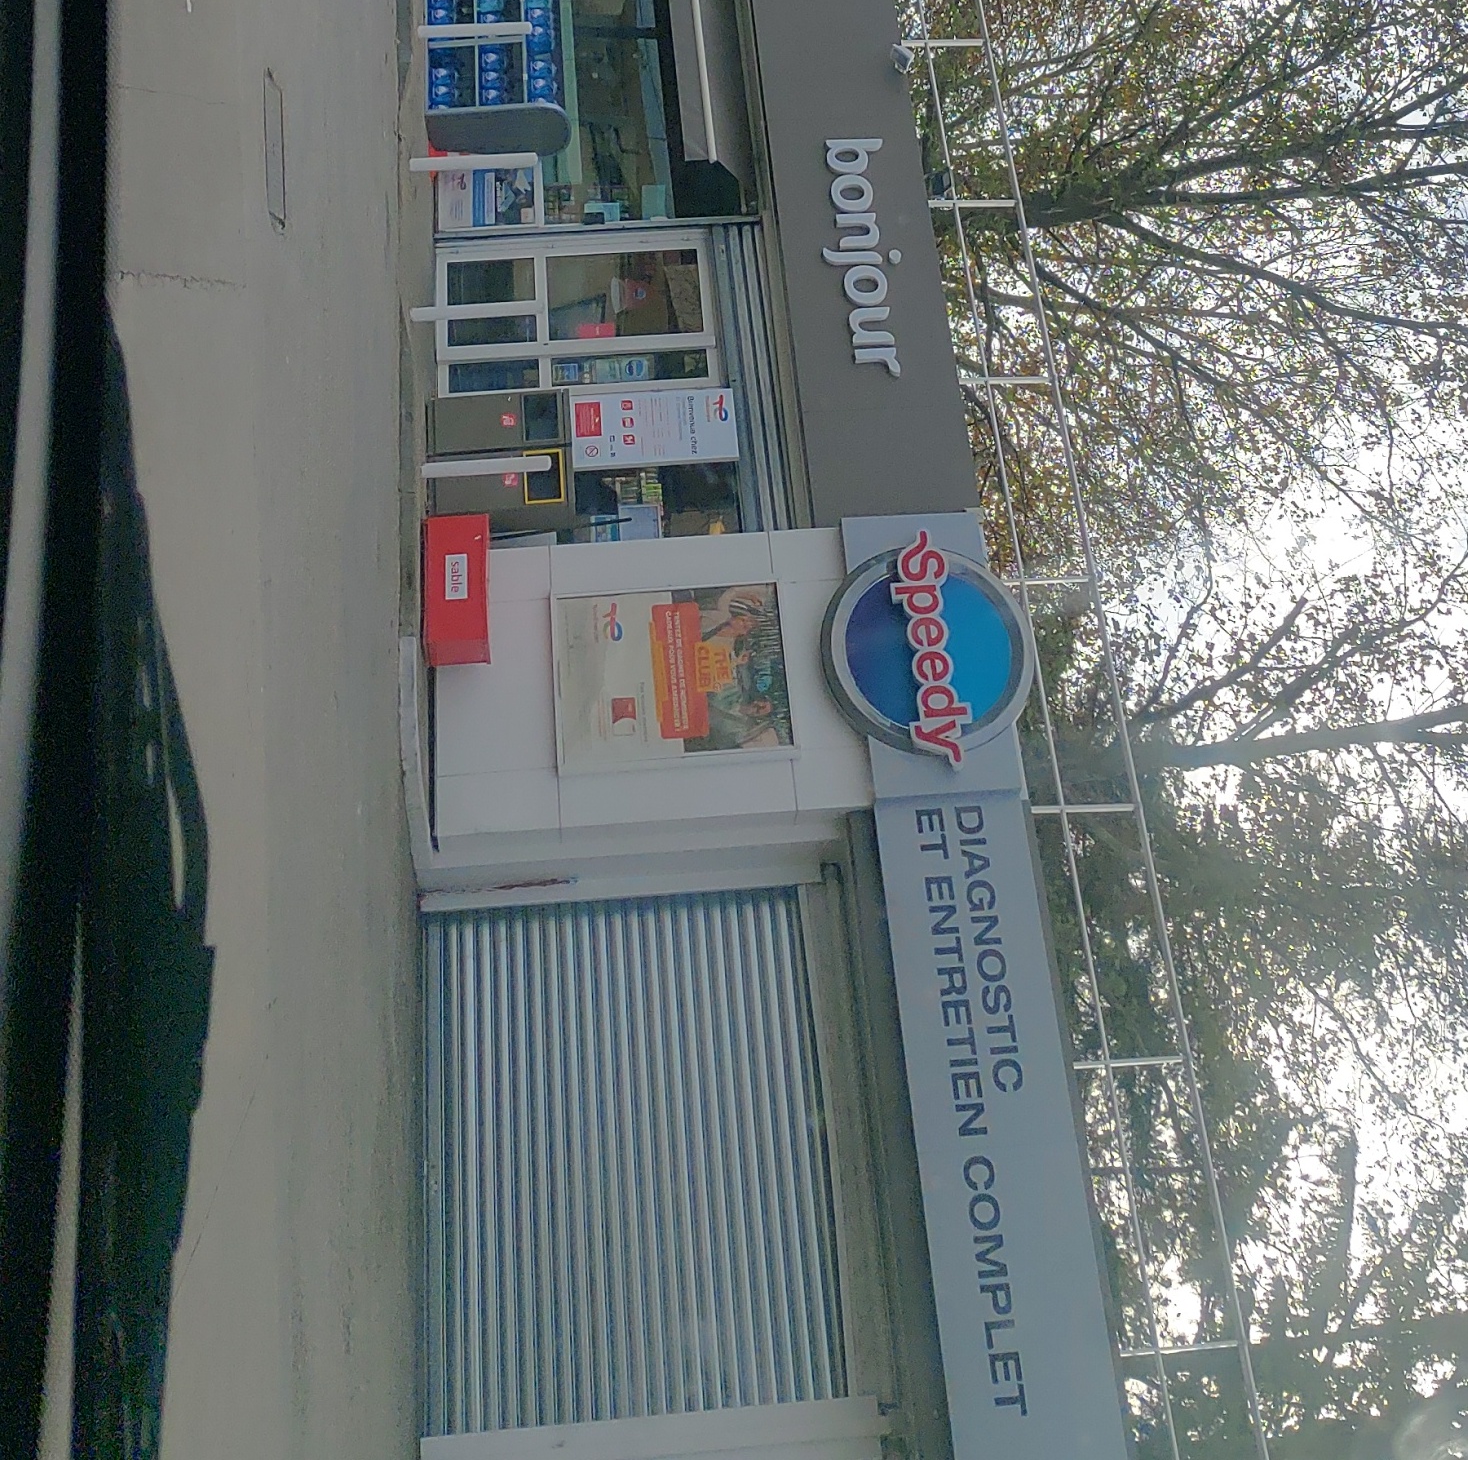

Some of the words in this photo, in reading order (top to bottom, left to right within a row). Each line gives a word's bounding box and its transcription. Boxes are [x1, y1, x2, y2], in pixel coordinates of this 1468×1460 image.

[821, 138, 902, 378] bonjour
[690, 436, 698, 454] chez
[450, 562, 463, 592] sable
[894, 530, 968, 763] Speedy
[698, 646, 712, 687] CLUB
[714, 650, 728, 681] THE
[915, 808, 950, 860] ET
[924, 876, 988, 1137] ENTRETIEN
[954, 806, 1024, 1092] DIAGNOSTIC
[963, 1155, 1028, 1417] COMPLET
